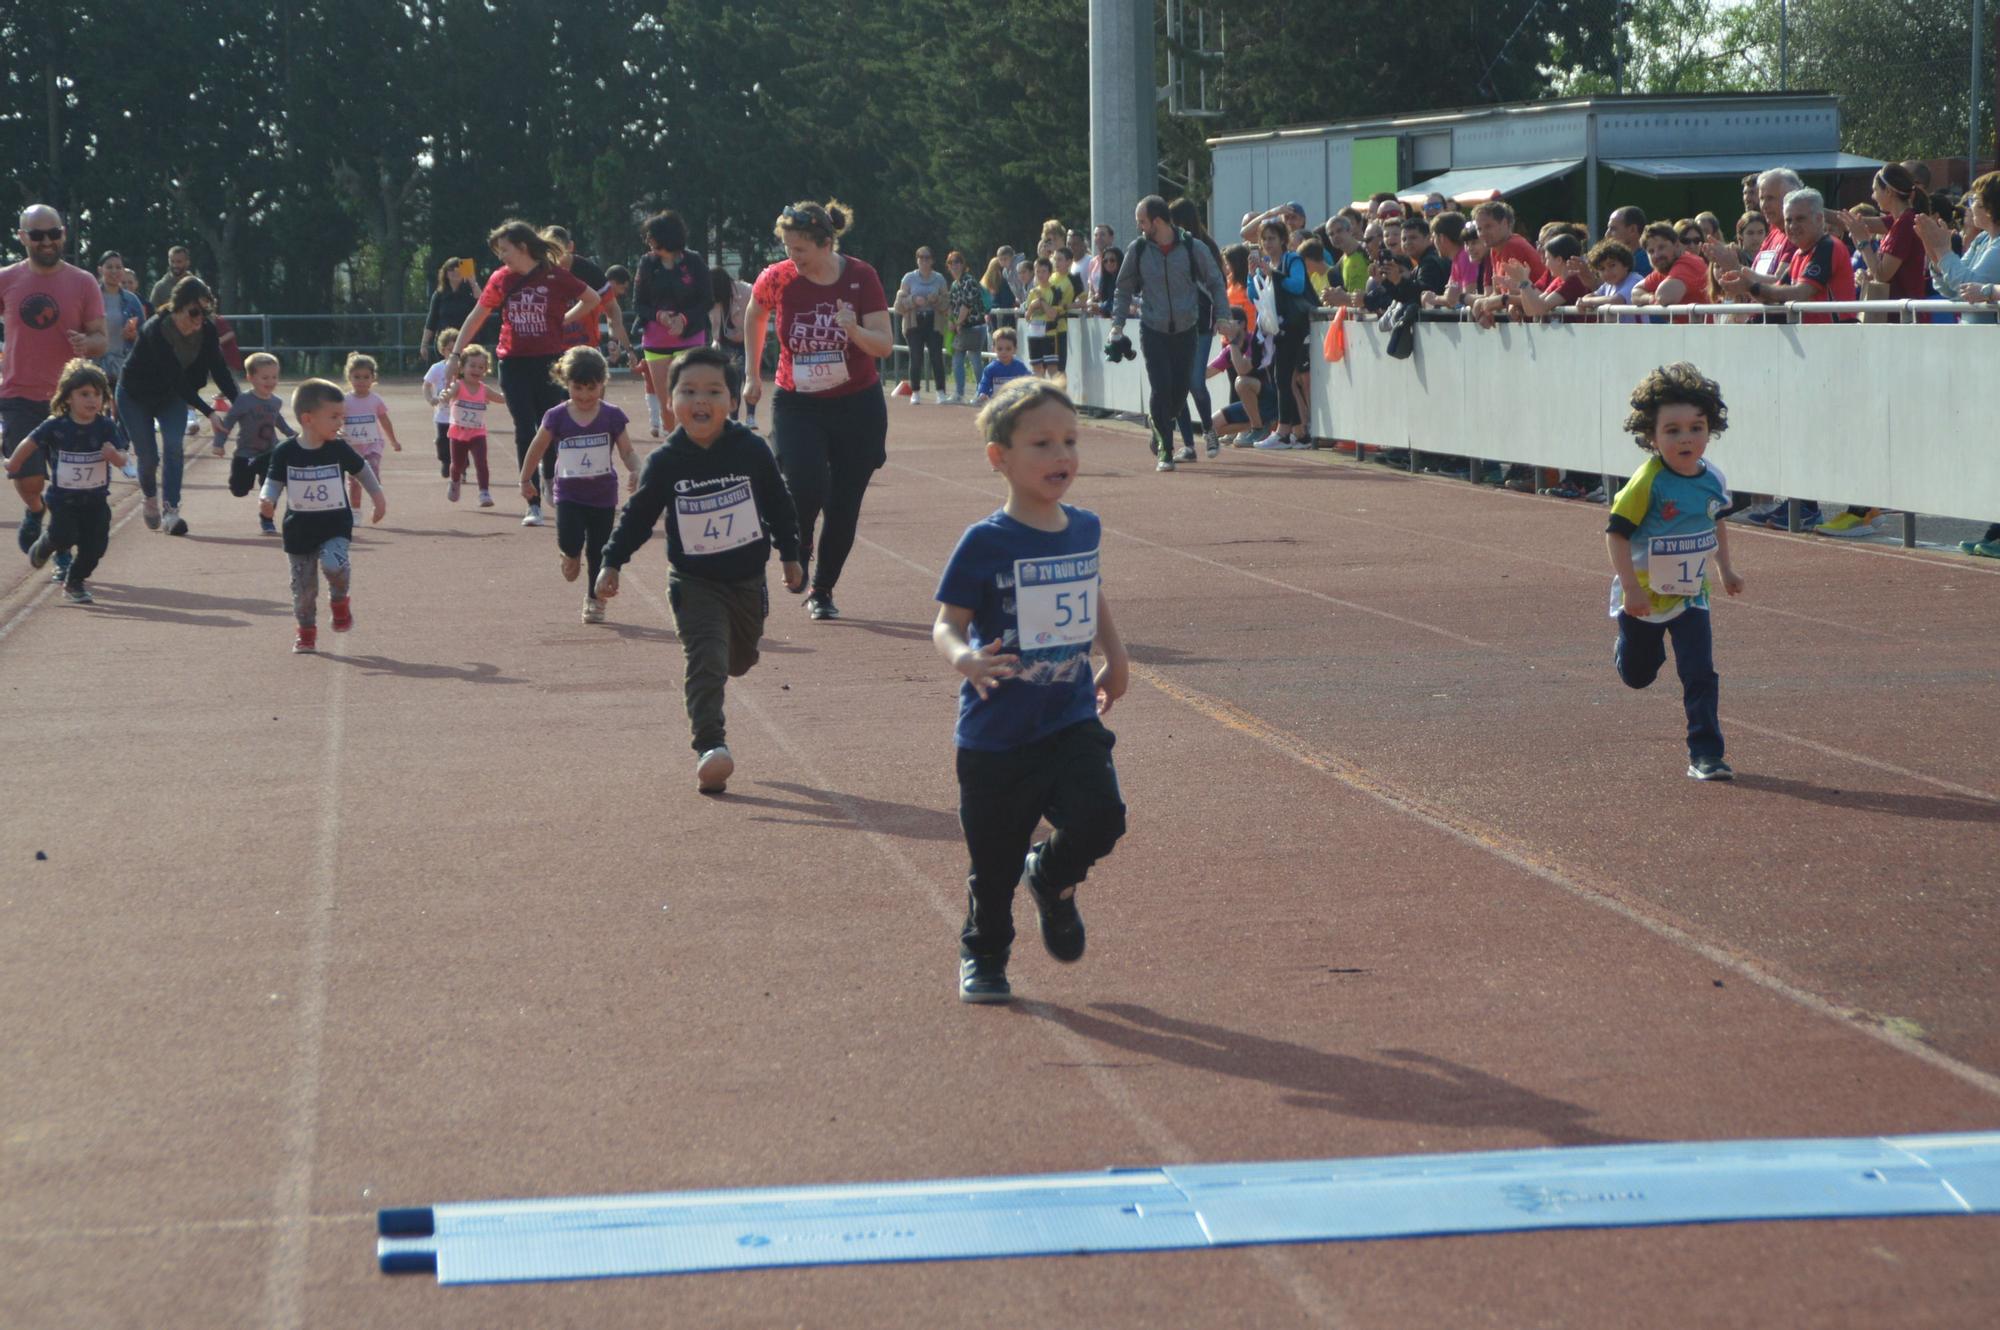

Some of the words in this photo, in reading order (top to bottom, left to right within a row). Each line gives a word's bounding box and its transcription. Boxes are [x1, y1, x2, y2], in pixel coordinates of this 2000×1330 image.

[509, 303, 545, 313] RUN
[815, 314, 833, 327] XV
[794, 325, 848, 342] RUN
[461, 410, 477, 423] 22
[351, 426, 368, 438] 44
[580, 452, 593, 469] 4
[72, 467, 94, 482] 37
[674, 473, 751, 493] Champion
[303, 484, 329, 502] 48
[688, 501, 700, 512] XV
[700, 498, 718, 511] RUN
[718, 486, 747, 507] CASTELL
[703, 513, 734, 540] 47
[1666, 541, 1678, 552] XV
[1679, 539, 1696, 550] RUN
[1039, 564, 1053, 580] XV
[1054, 561, 1077, 579] RUN
[1054, 589, 1091, 627] 51
